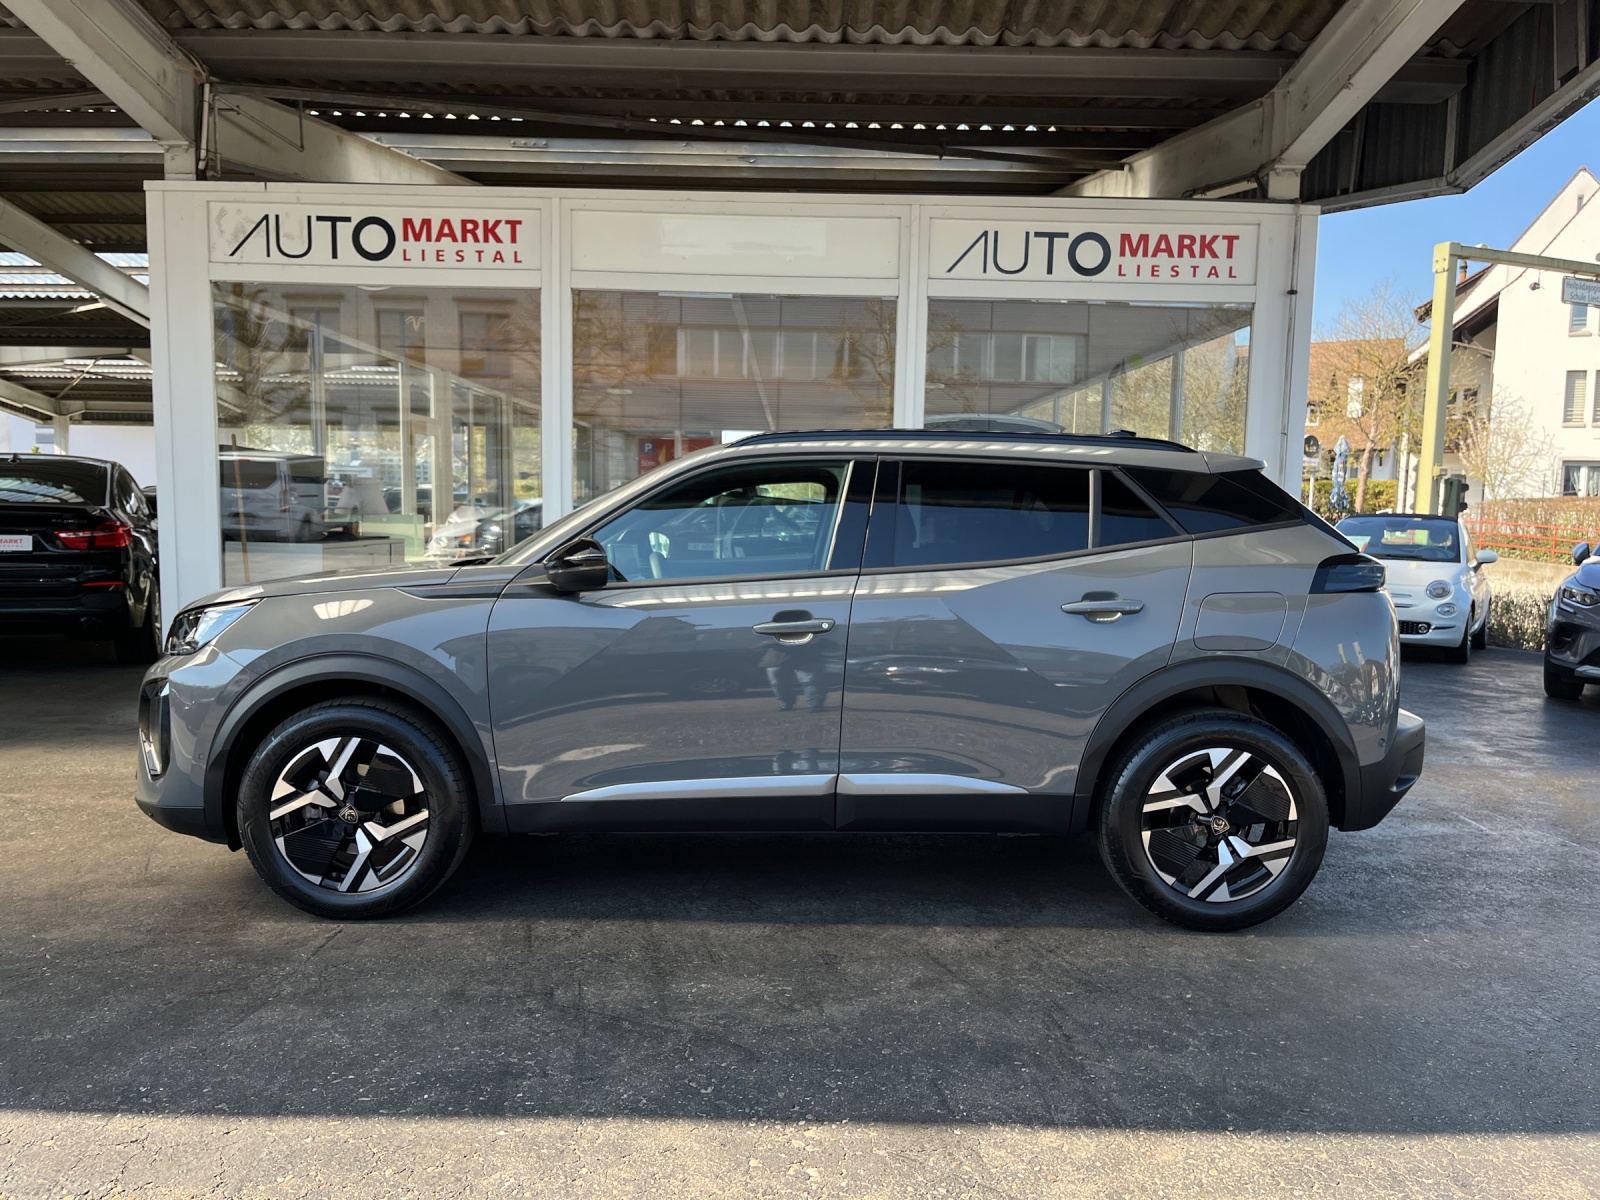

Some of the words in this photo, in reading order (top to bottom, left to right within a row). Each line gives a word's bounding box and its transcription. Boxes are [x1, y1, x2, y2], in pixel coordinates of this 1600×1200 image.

[229, 213, 396, 262] AUTO
[402, 217, 523, 244] MARKT
[402, 248, 523, 264] LIESTAL
[945, 229, 1112, 277] AUTO
[1118, 233, 1240, 259] MARKT
[1117, 263, 1238, 279] LIESTAL
[644, 443, 652, 453] P
